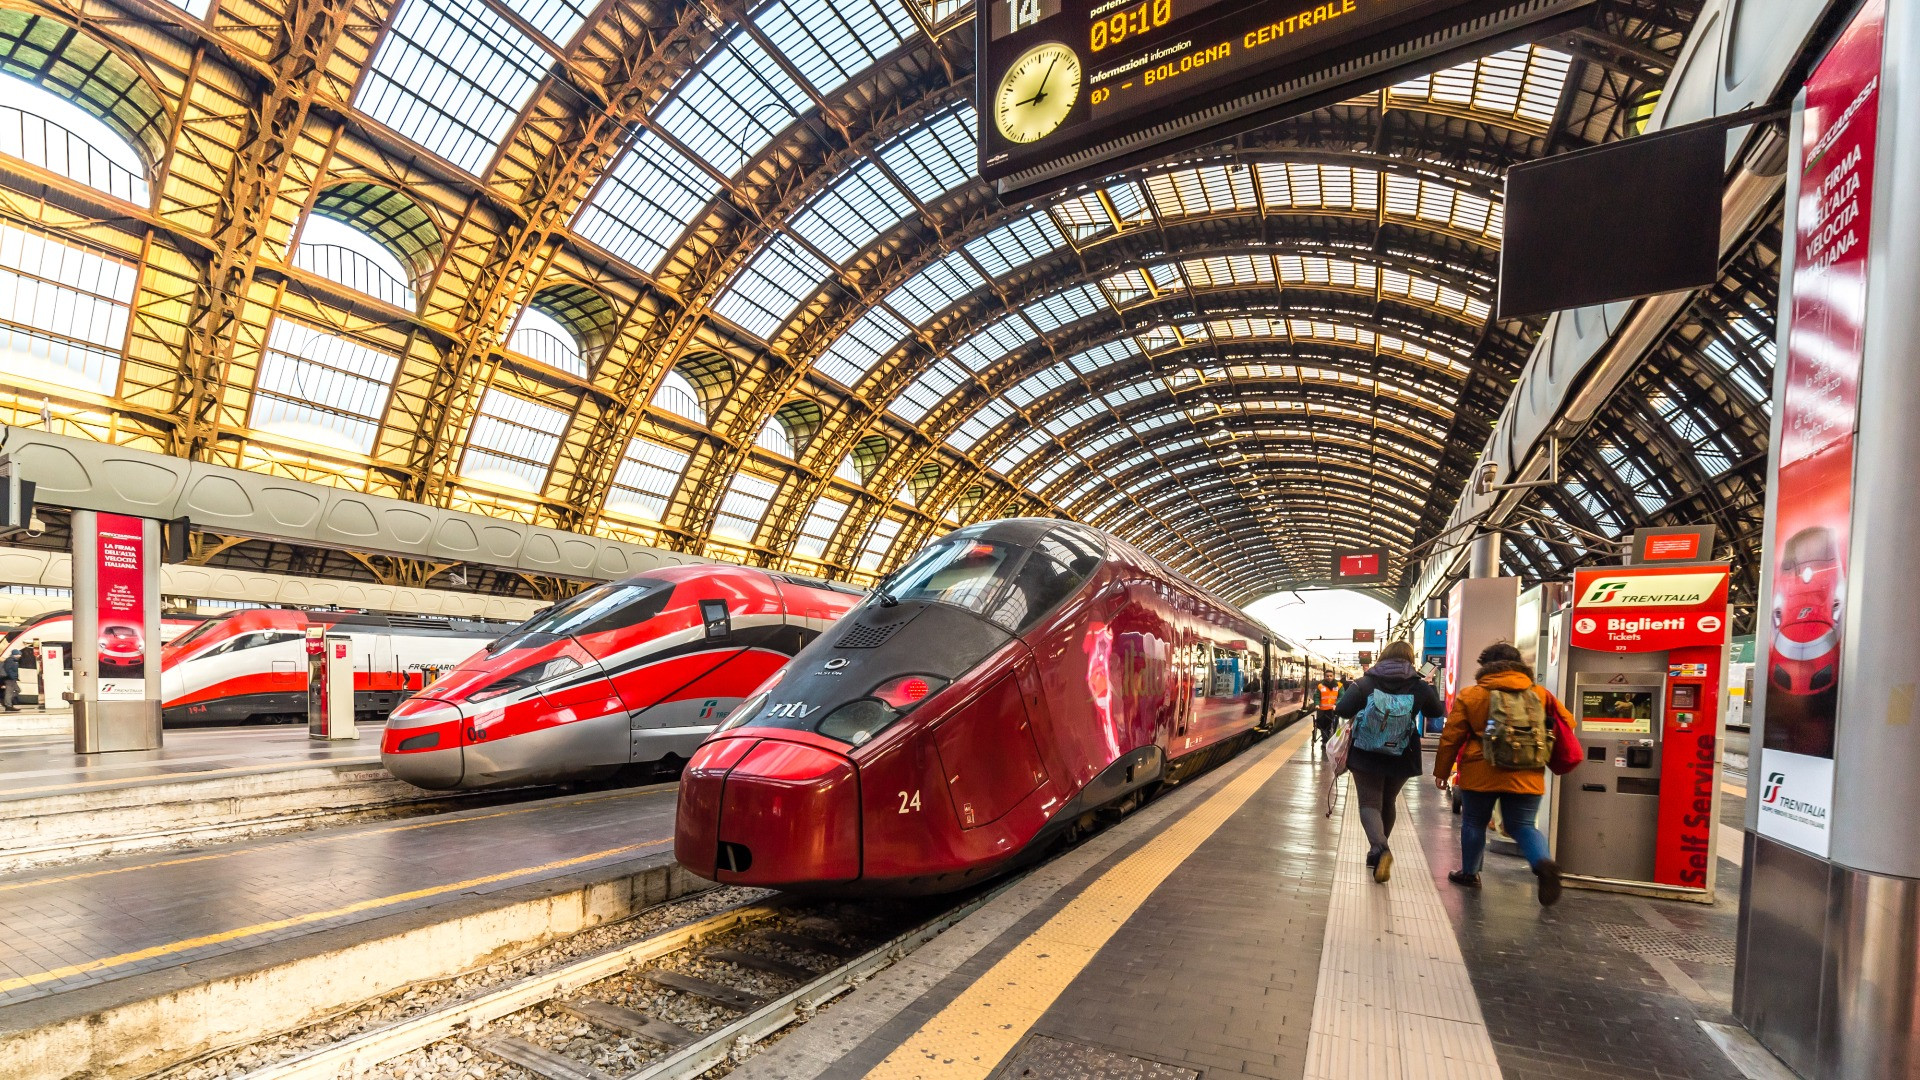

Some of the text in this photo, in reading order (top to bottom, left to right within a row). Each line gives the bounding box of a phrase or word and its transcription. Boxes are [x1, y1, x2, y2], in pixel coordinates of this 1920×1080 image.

[1090, 0, 1171, 52] 09:10
[1144, 41, 1231, 86] BOLOGNA
[1243, 0, 1357, 49] CENTRALE
[1090, 39, 1191, 84] informazioni information
[1824, 144, 1861, 196] FIRMA
[1806, 195, 1859, 261] VELOCITÀ
[104, 549, 136, 557] DELL'ALTA
[105, 555, 137, 563] VELOCITÀ
[1622, 593, 1700, 603] TRENITALIA
[1607, 617, 1685, 633] Biglietti
[1607, 632, 1641, 641] Tickets
[188, 704, 207, 715] 19-A
[767, 701, 822, 719] ntv
[898, 789, 921, 814] 24
[1680, 734, 1715, 885] Self Service
[1780, 796, 1826, 819] TRENITALIA
